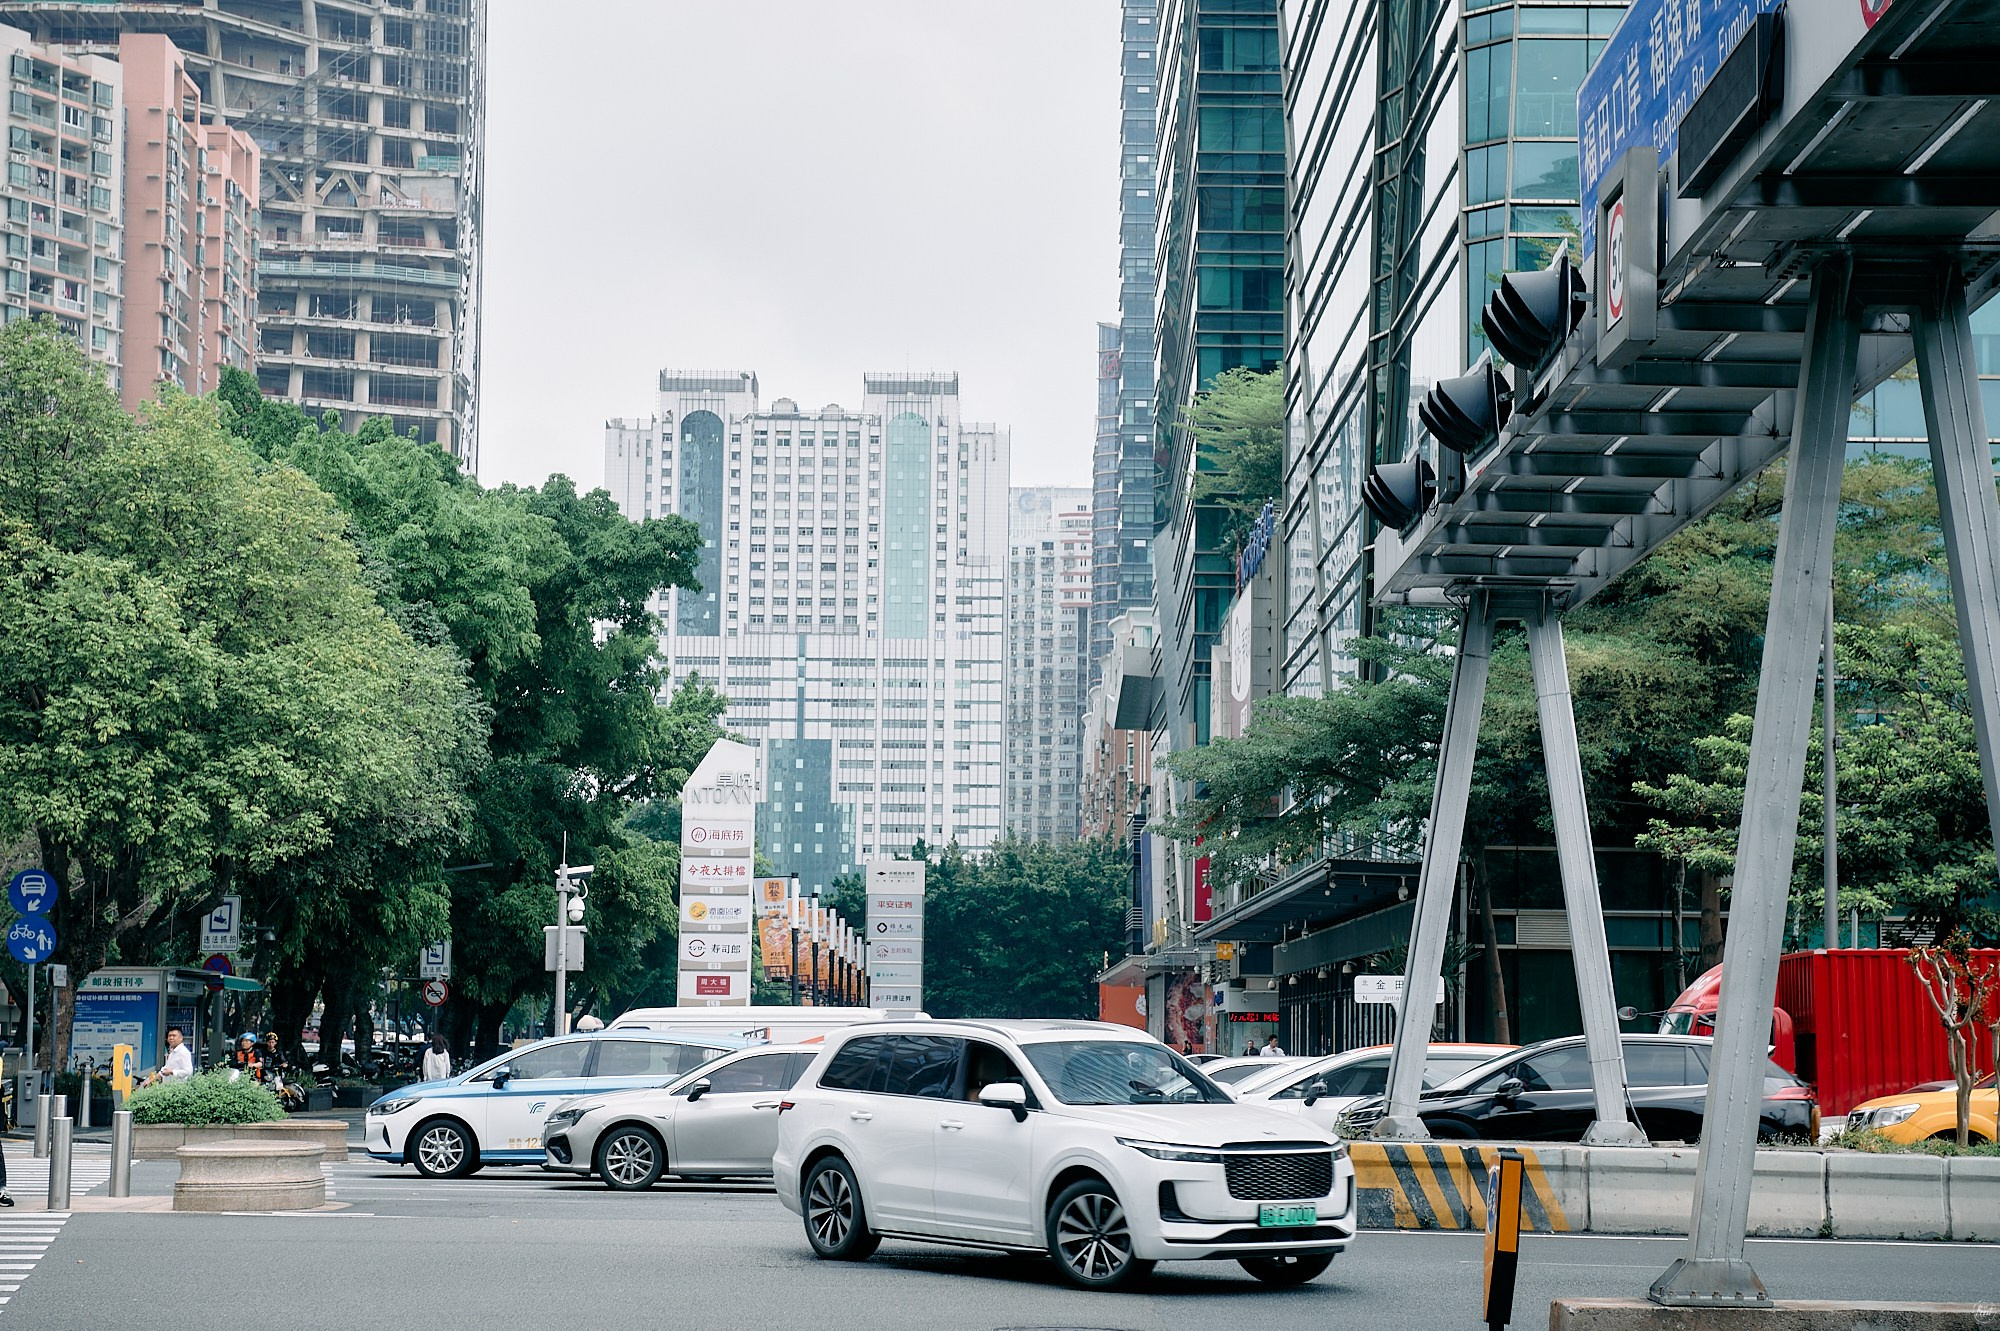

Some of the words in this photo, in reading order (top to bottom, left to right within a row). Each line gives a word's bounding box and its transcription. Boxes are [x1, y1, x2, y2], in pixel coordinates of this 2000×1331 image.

[1718, 2, 1749, 64] Fumin
[1692, 55, 1705, 100] Rd
[1583, 42, 1642, 193] 福田口岸
[716, 771, 753, 788] 卓悦
[708, 829, 744, 841] 海底捞
[687, 864, 746, 876] 今夜大排檔
[203, 935, 236, 944] 违法抓拍
[711, 944, 741, 954] 寿司郎
[92, 977, 144, 987] 邮政报刊亭
[700, 978, 727, 986] 周大福
